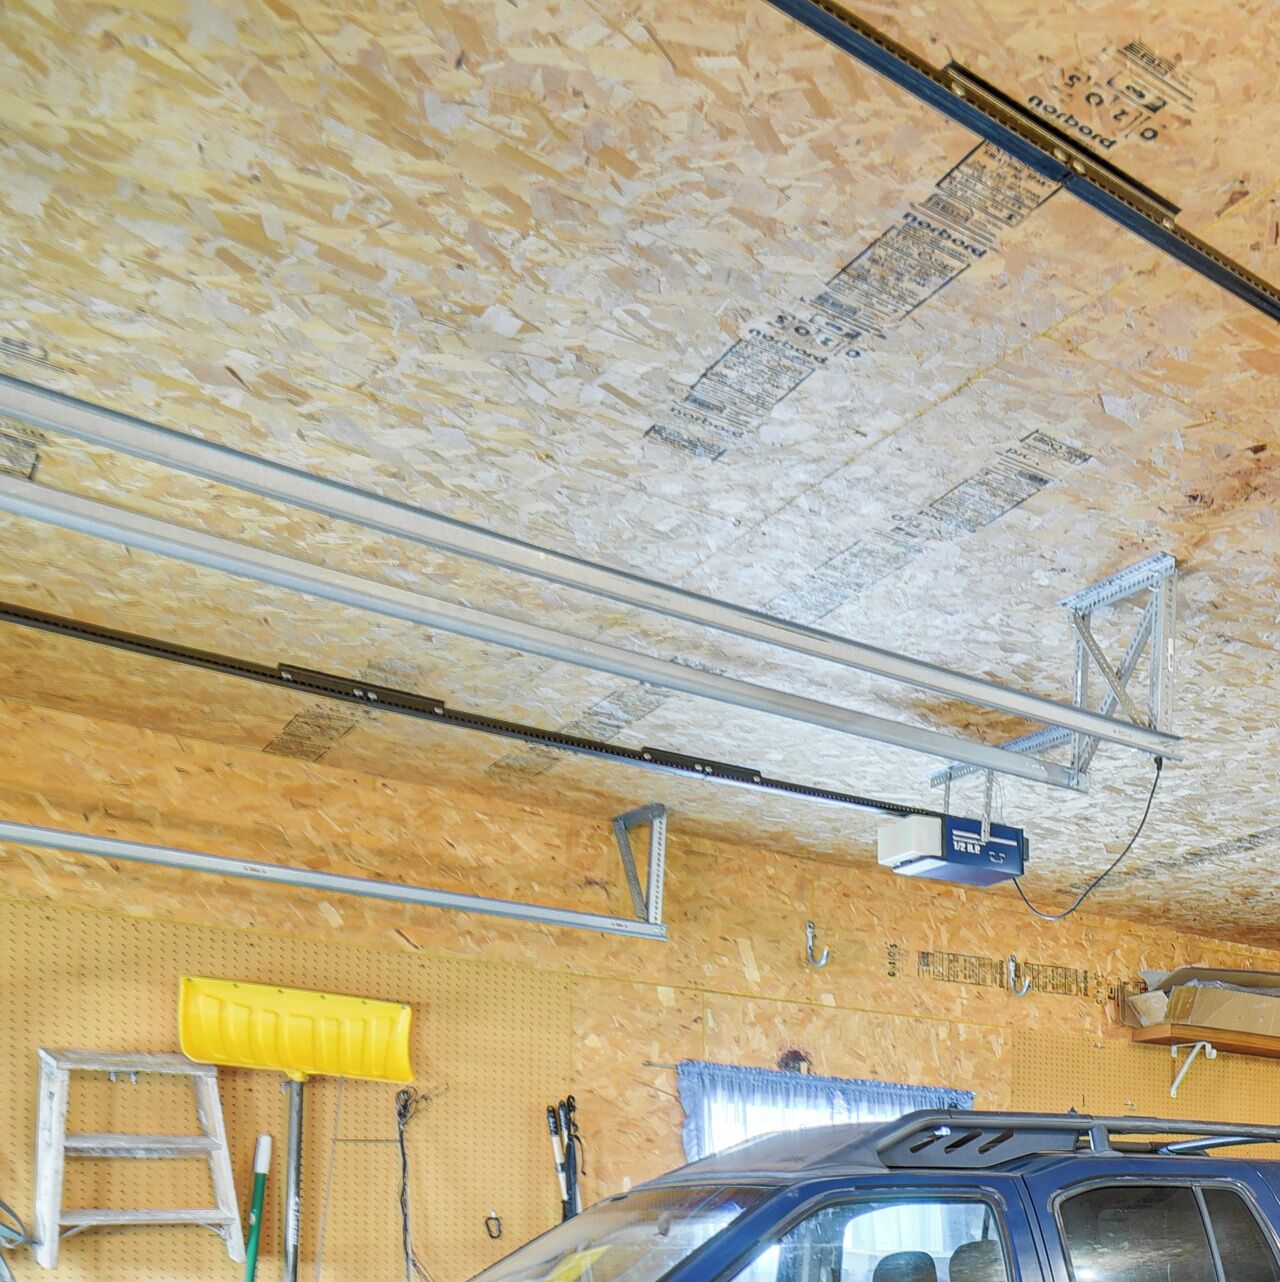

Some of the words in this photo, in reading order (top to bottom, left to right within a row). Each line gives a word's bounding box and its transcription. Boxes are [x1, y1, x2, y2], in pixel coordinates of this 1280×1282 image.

[1028, 95, 1118, 149] norbord
[902, 212, 988, 258] norbord
[748, 328, 829, 364] norbord
